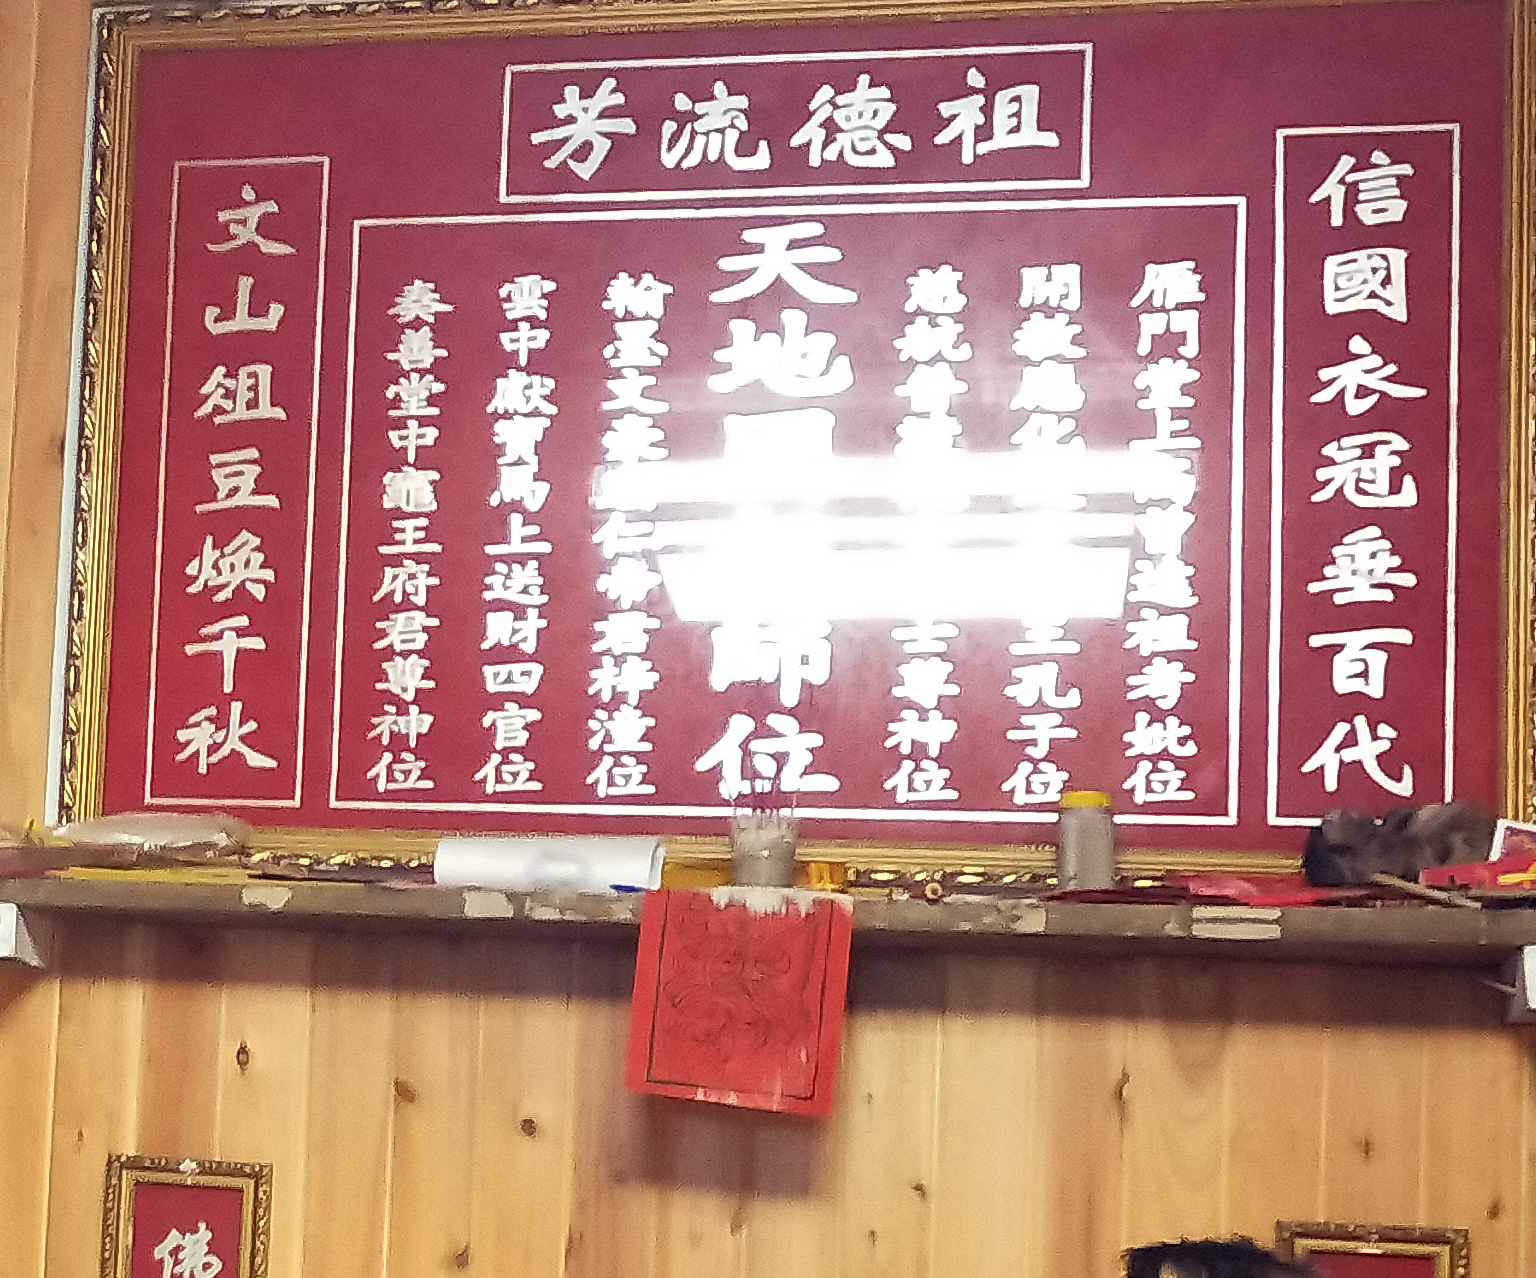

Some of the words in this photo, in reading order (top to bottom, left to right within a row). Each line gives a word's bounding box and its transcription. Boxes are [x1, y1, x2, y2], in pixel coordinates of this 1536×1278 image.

[694, 221, 859, 800] 天地師位
[1300, 149, 1429, 798] 信國衣冠垂百代
